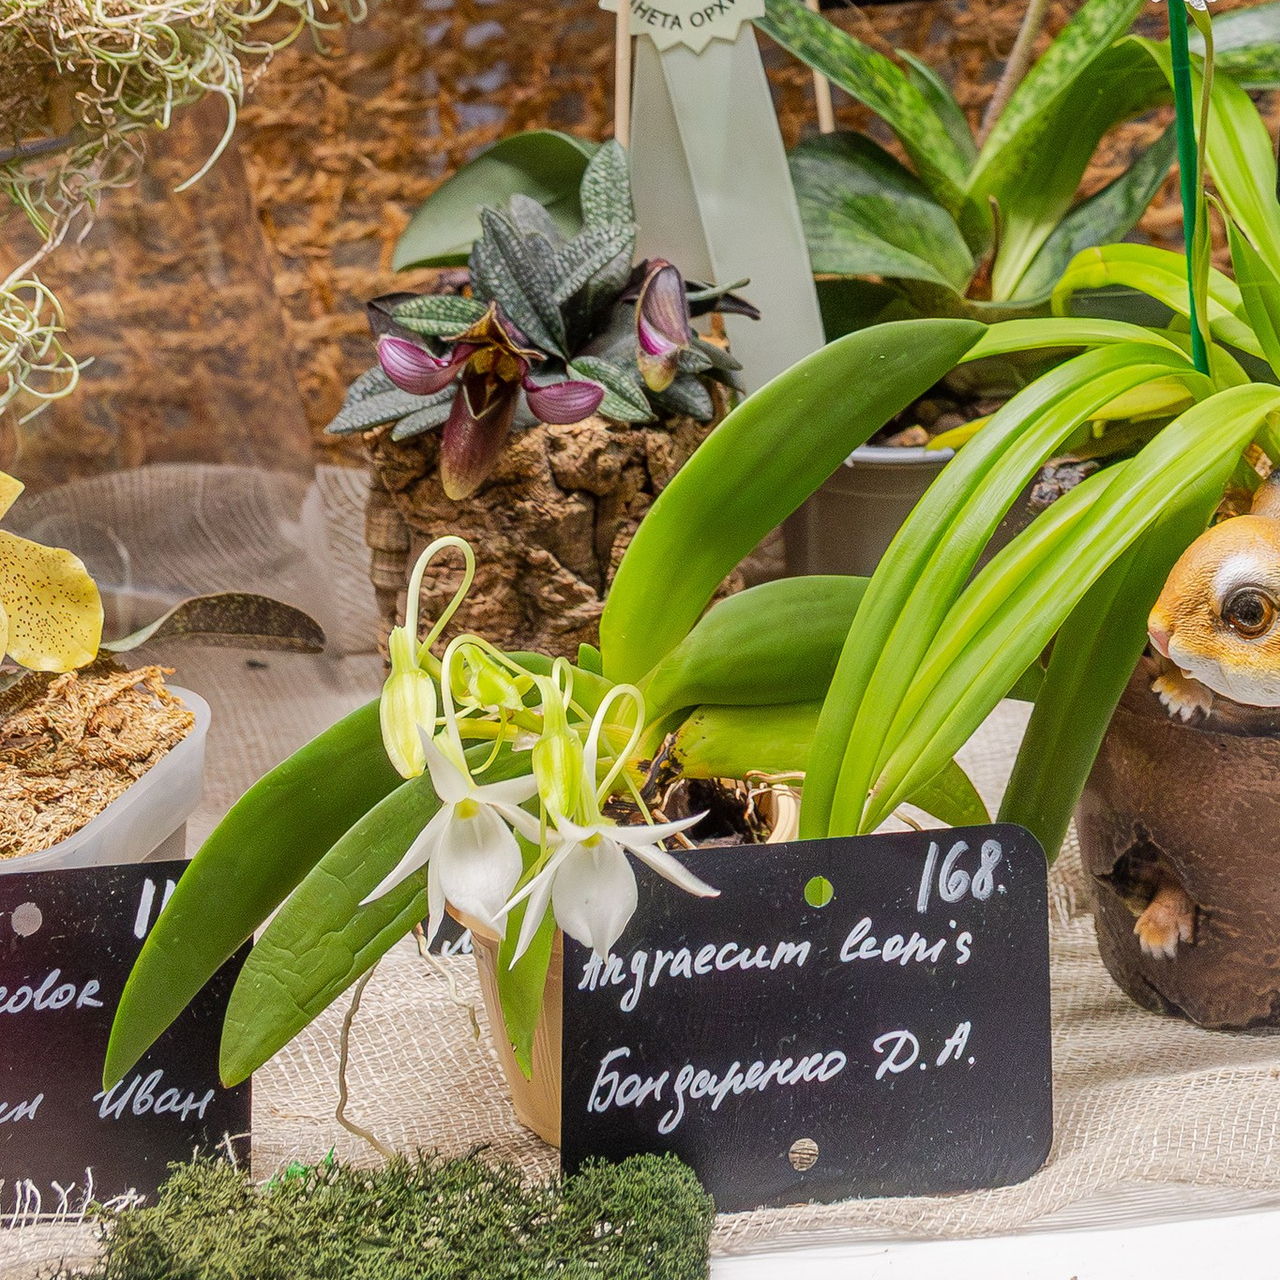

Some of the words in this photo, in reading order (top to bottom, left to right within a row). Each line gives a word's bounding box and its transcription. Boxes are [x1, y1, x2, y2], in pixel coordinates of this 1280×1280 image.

[577, 941, 812, 1012] Angraecum
[93, 1068, 216, 1122] Иван
[586, 1047, 848, 1136] Бондаренко
